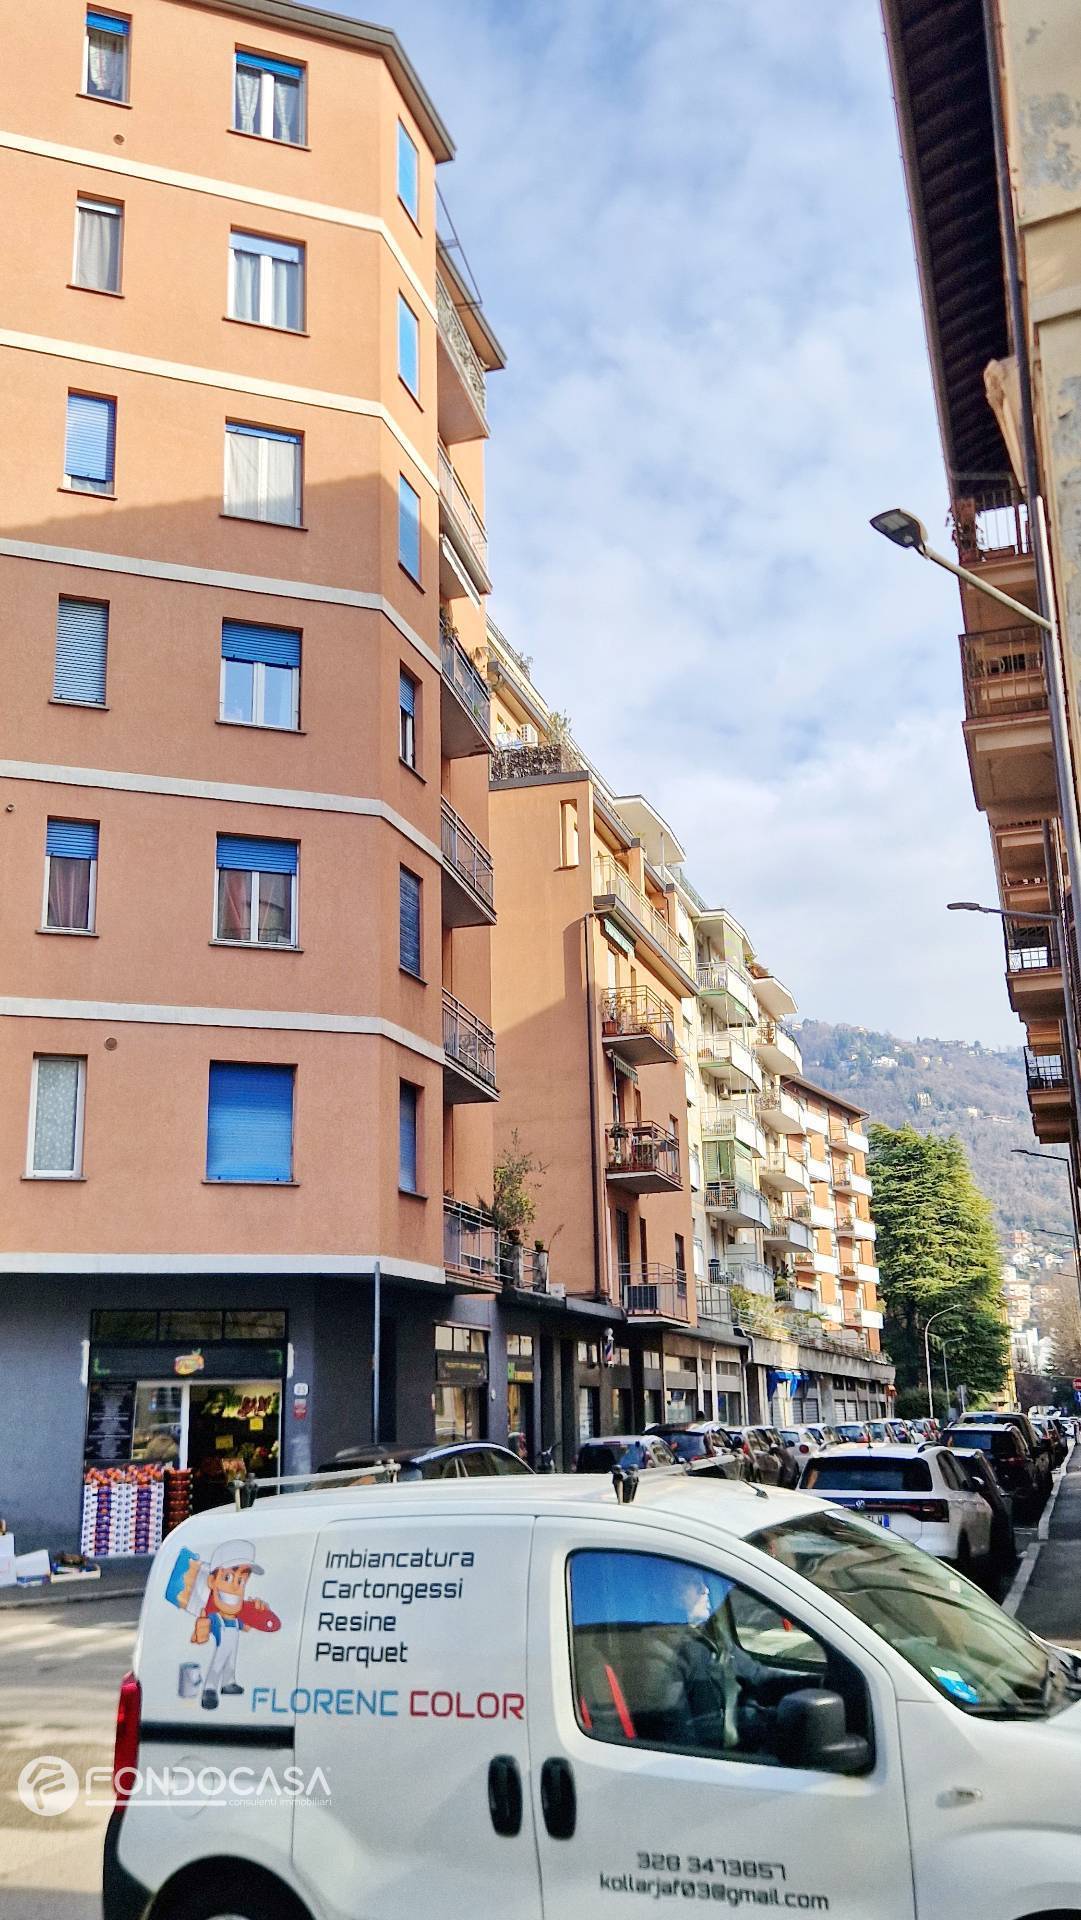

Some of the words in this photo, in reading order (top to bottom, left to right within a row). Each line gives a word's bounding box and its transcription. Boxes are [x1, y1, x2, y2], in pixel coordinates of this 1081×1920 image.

[325, 1547, 475, 1569] Imbiancatura
[321, 1577, 464, 1605] Cartongessi
[317, 1611, 397, 1632] Resine
[315, 1641, 408, 1668] Parquet
[251, 1687, 399, 1717] FLORENC
[409, 1690, 525, 1720] COLOR
